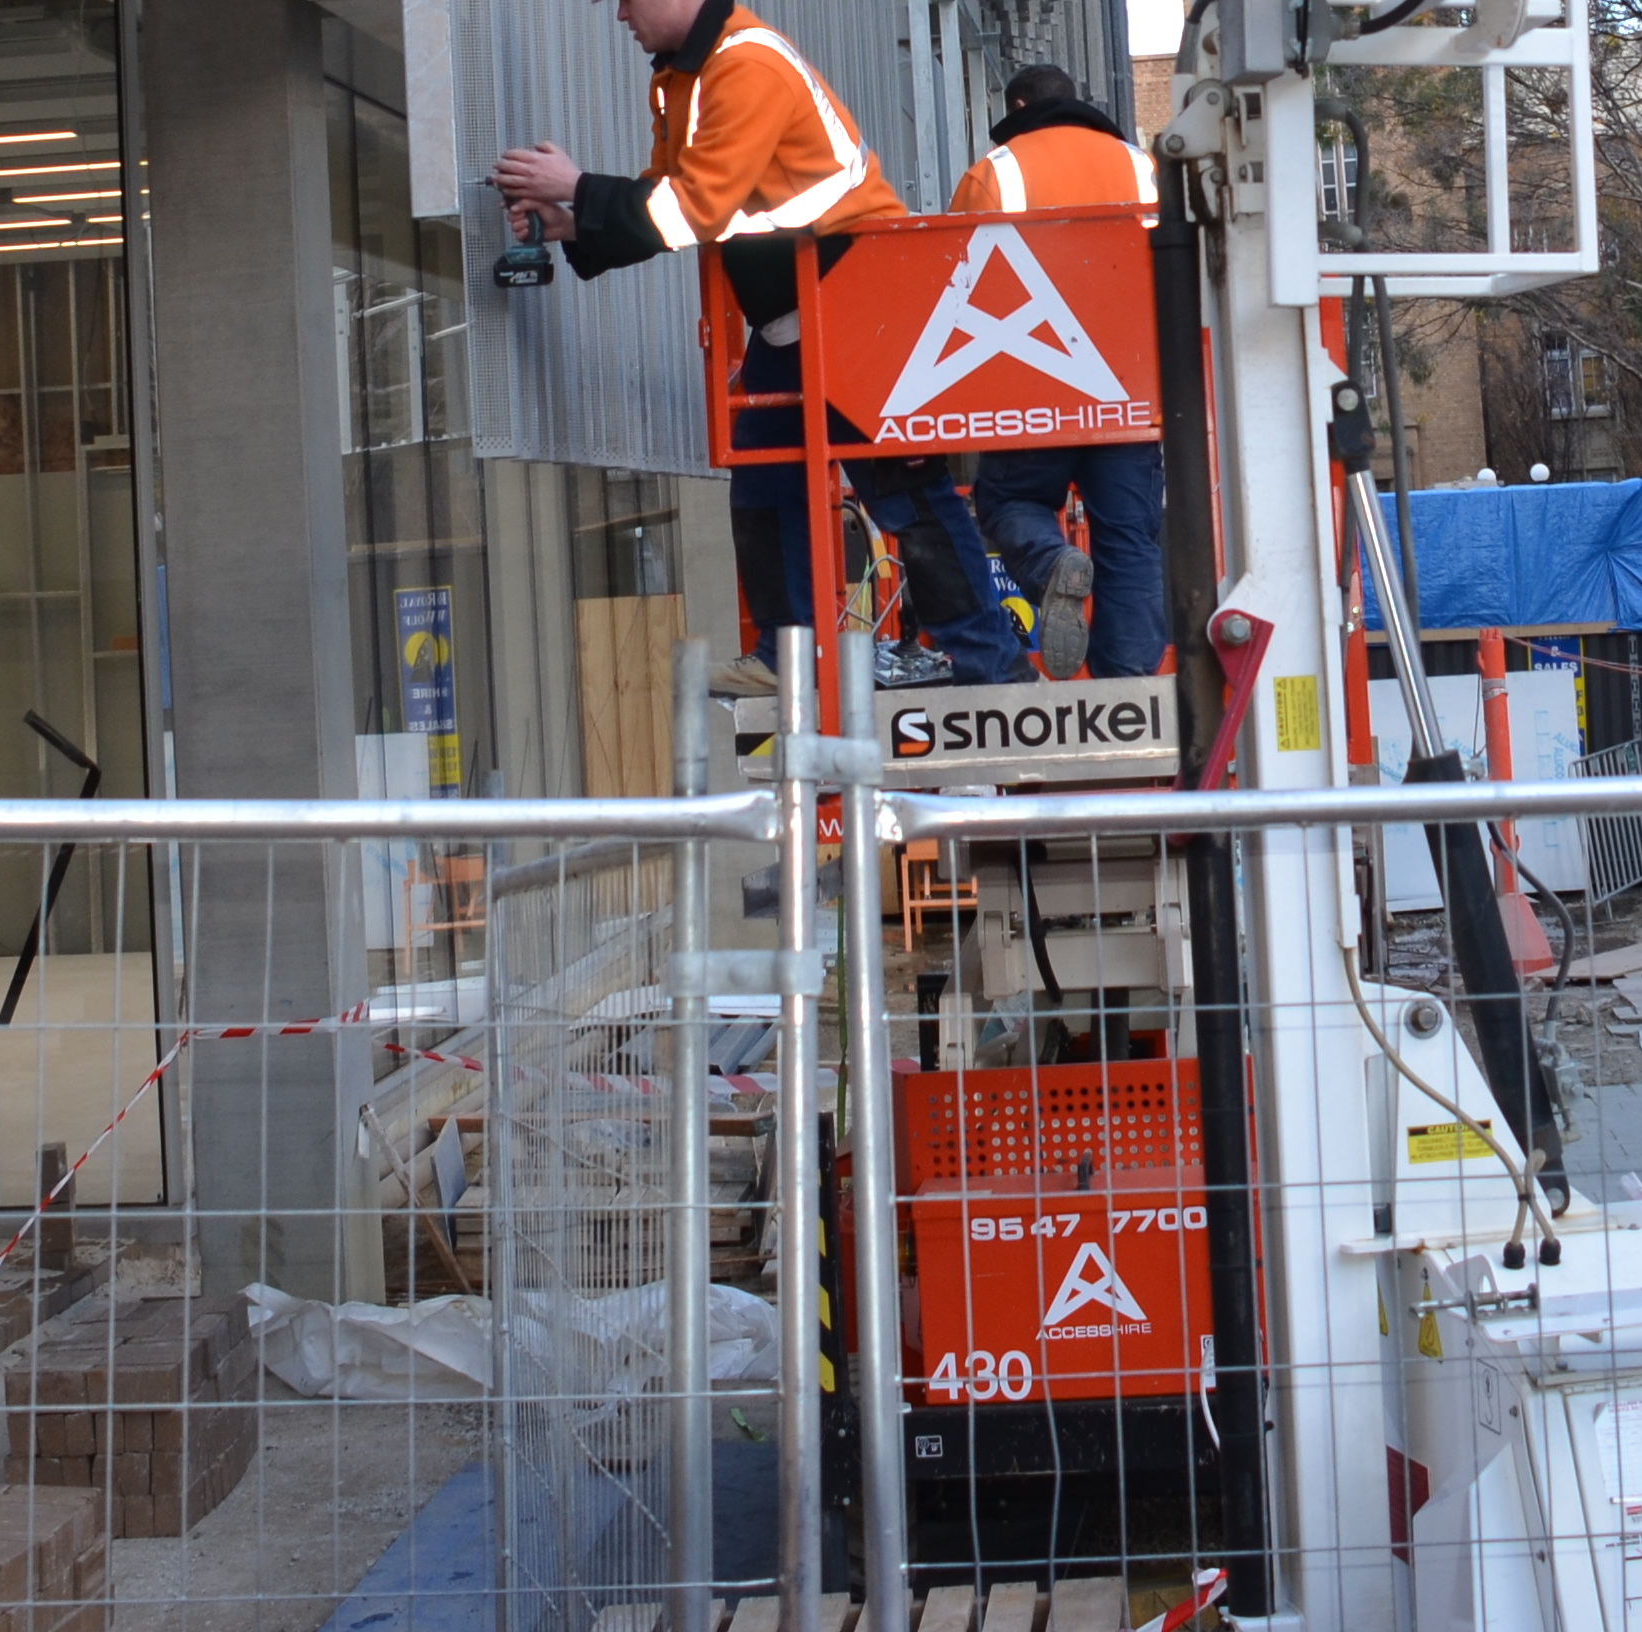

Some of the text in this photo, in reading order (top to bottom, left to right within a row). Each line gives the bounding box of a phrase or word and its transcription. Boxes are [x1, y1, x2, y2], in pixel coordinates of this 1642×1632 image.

[873, 401, 1153, 444] ACCESSHIRE
[942, 695, 1162, 751] snorkel
[1109, 1206, 1208, 1234] 7700
[929, 1350, 1033, 1401] 430
